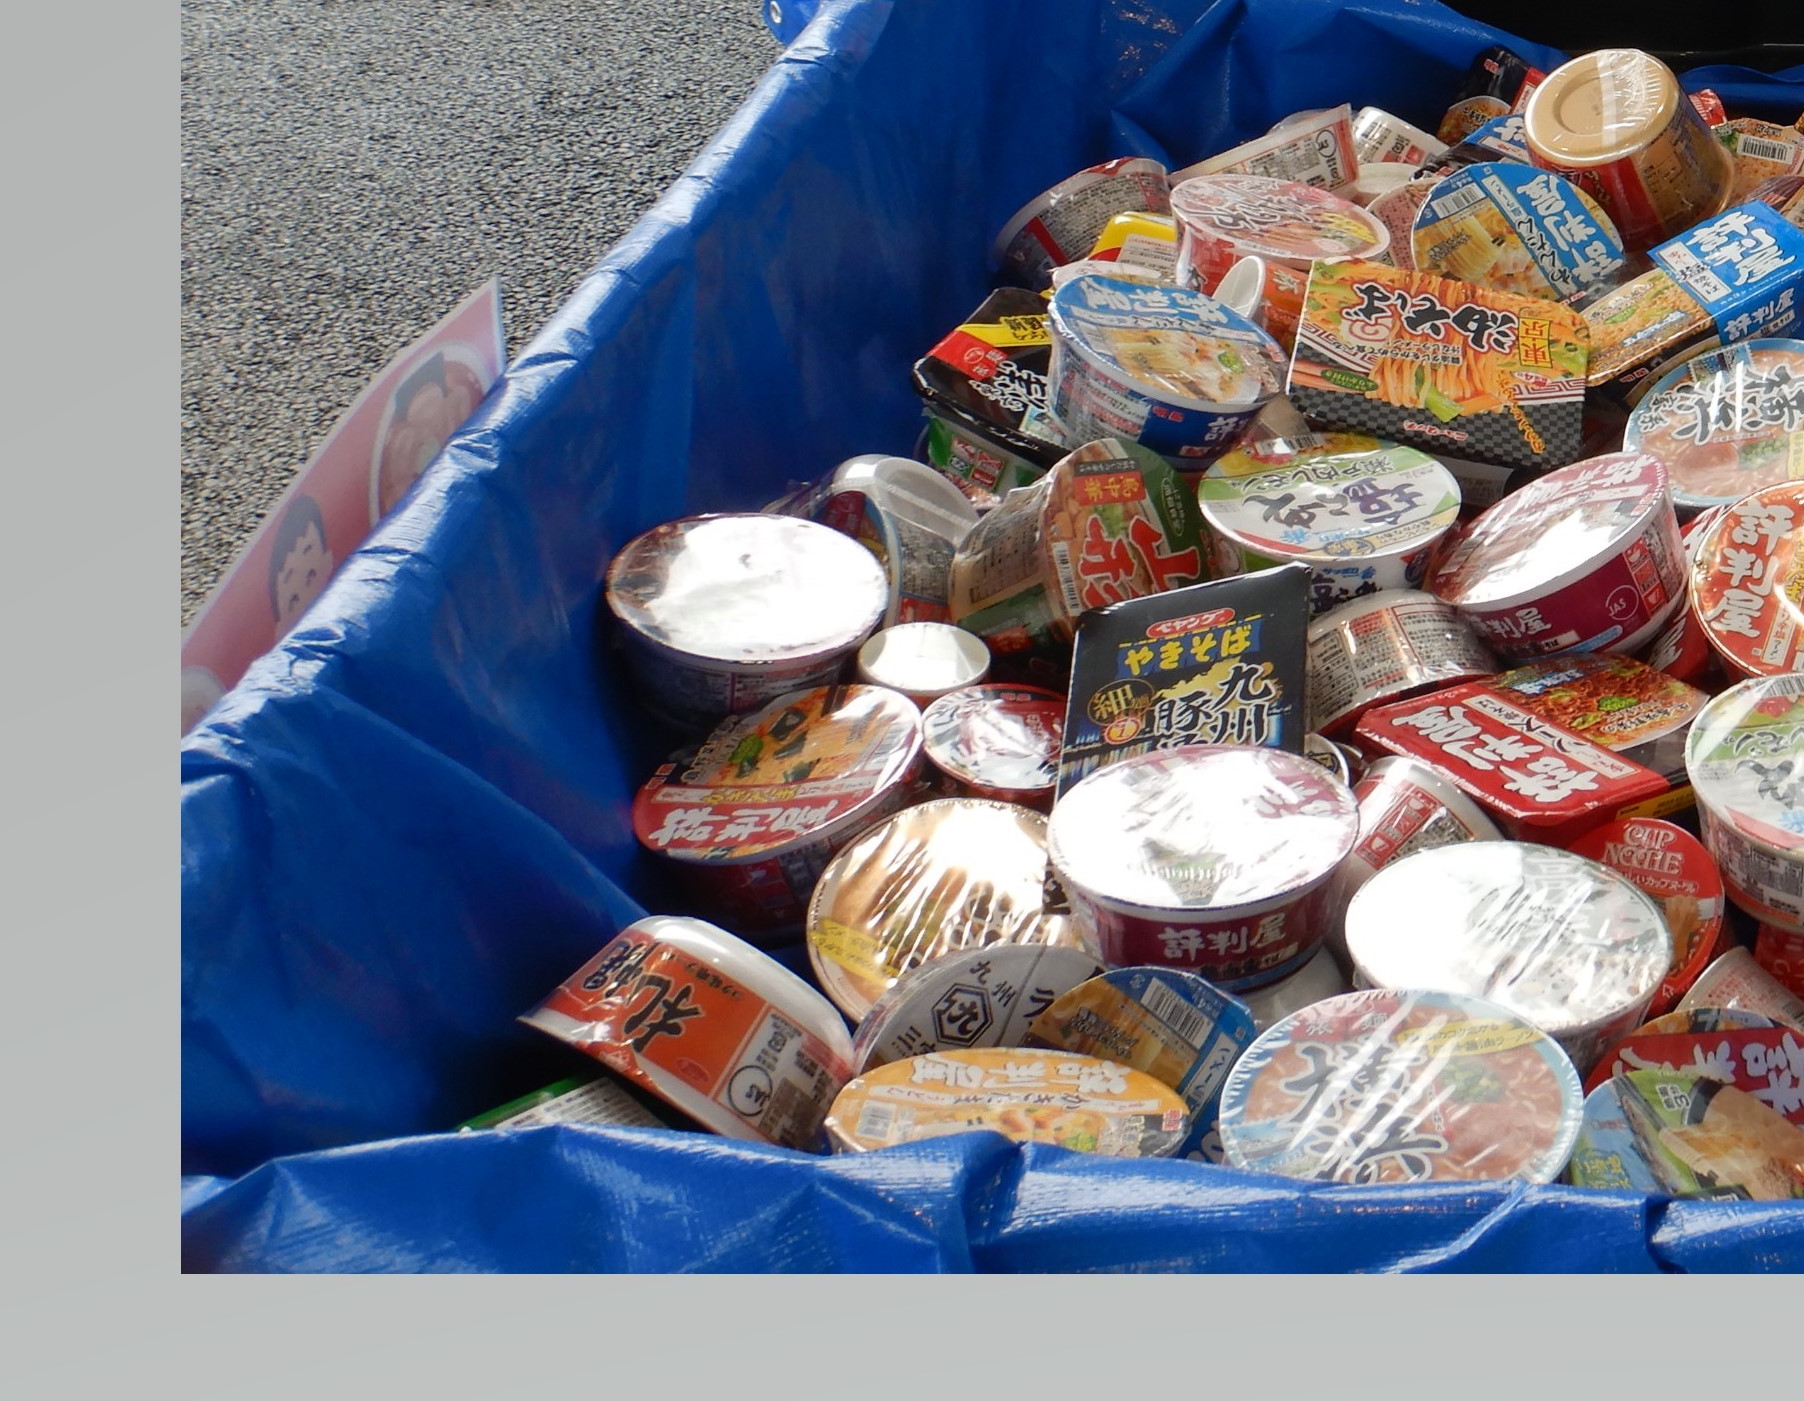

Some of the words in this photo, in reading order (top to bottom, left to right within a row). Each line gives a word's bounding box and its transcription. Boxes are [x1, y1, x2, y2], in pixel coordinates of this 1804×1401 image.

[1519, 174, 1624, 289] 評判屋
[1686, 212, 1798, 285] 評判屋
[1344, 283, 1519, 353] 油そば
[1725, 289, 1794, 339] 評判屋
[1521, 317, 1551, 367] 東京
[1711, 504, 1801, 637] 評判屋
[1155, 610, 1232, 634] ペヤング
[1607, 594, 1634, 619] JAS
[1125, 624, 1252, 676] やきそば
[1214, 662, 1276, 746] 九州
[1391, 702, 1599, 808] 評判屋
[649, 800, 838, 847] 評判屋
[1624, 822, 1676, 850] CUP
[1603, 841, 1684, 875] NOODLE
[1158, 913, 1288, 962] 評判屋
[582, 937, 703, 1054] 札幌
[968, 958, 1020, 1009] 九州
[908, 1057, 1134, 1097] 評判屋
